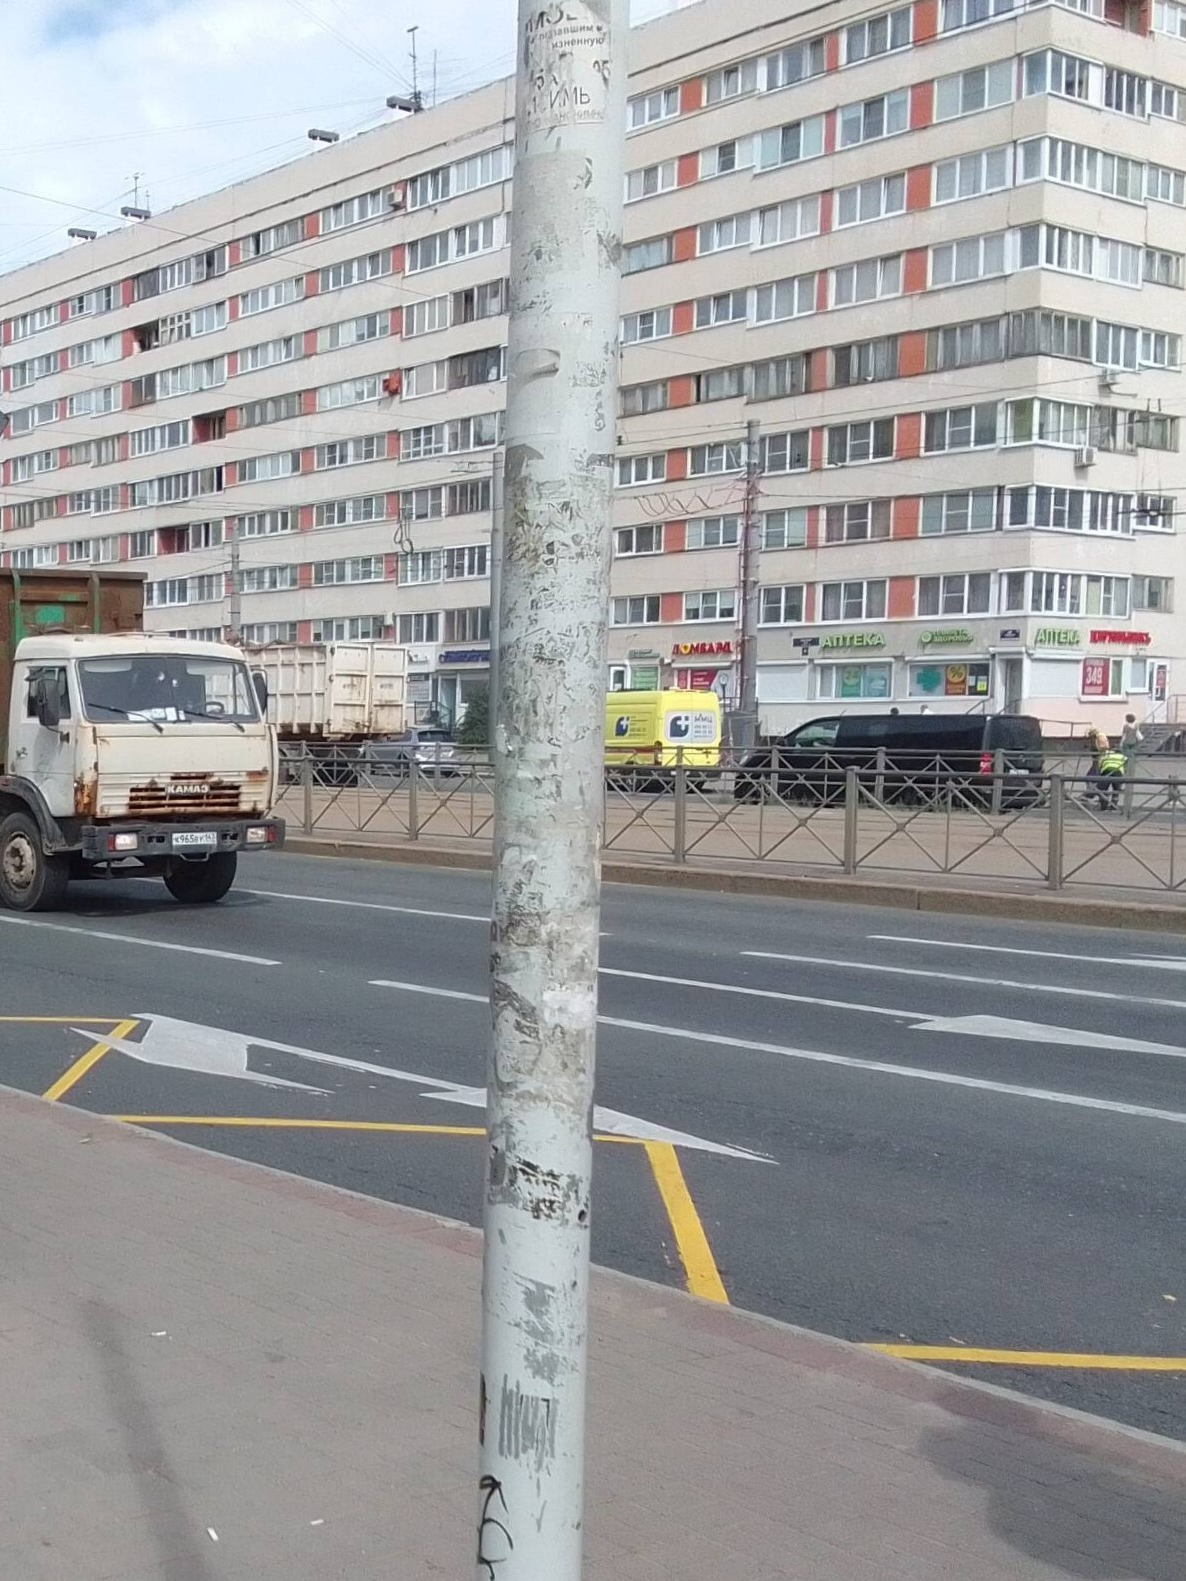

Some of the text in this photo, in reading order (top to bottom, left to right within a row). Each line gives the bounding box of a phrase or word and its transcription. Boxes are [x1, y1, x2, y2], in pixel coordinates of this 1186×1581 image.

[821, 632, 886, 649] АПТЕКА
[1036, 628, 1080, 645] АПТЕКА
[167, 784, 210, 794] КАМАЗ
